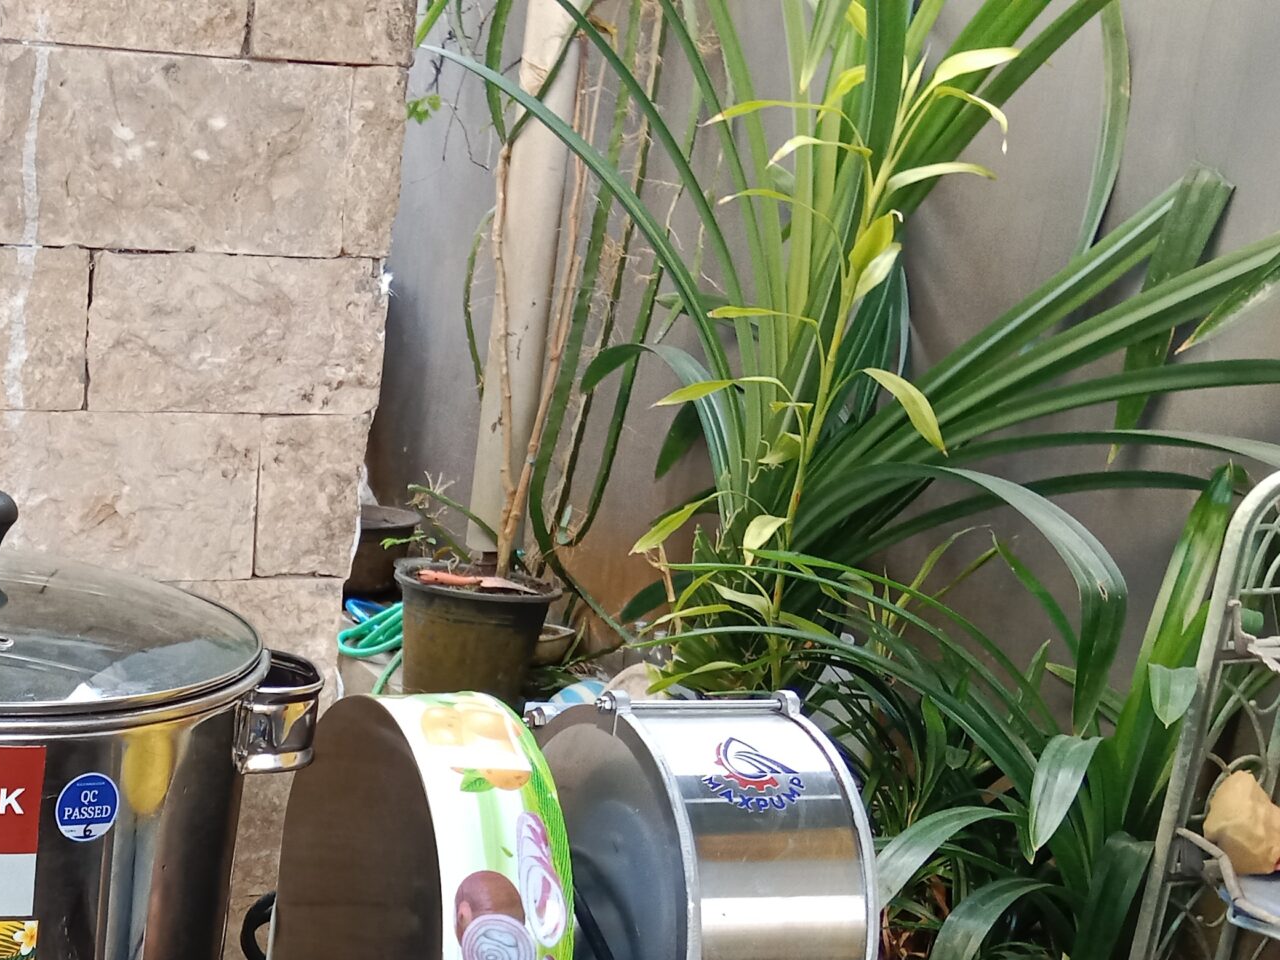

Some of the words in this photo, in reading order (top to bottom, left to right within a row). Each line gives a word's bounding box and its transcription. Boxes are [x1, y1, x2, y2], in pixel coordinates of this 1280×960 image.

[81, 790, 99, 805] QC
[701, 775, 806, 813] MAXPUMP
[63, 805, 111, 820] PASSED
